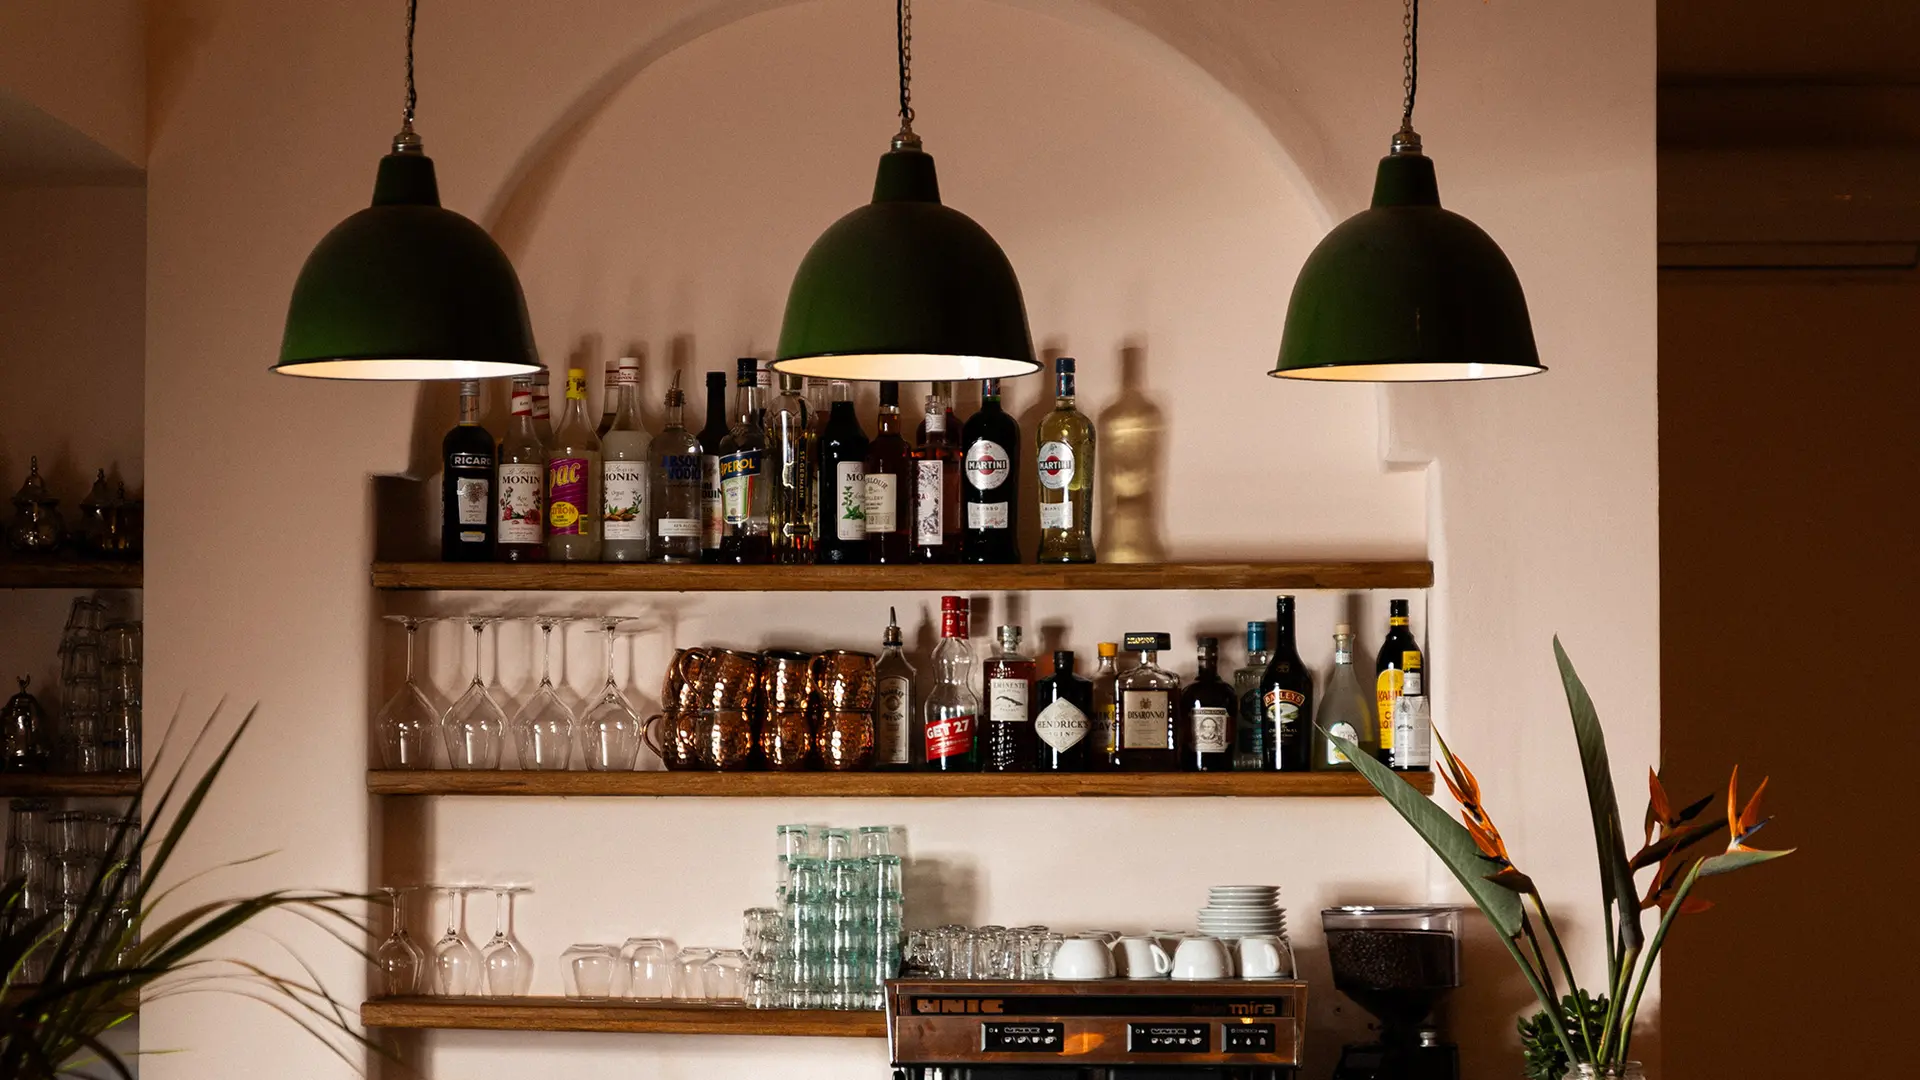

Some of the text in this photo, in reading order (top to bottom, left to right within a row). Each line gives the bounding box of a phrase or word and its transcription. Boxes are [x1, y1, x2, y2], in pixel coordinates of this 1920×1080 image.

[454, 456, 492, 465] RICARD
[968, 461, 1006, 470] MARTINI
[1039, 461, 1071, 470] MARTINI
[502, 476, 541, 484] MONIN
[1264, 690, 1303, 703] BALEYS
[1127, 711, 1165, 719] DISARONNO
[926, 718, 970, 740] GET 27
[917, 999, 1004, 1014] UNIC
[1229, 1000, 1277, 1015] mira
